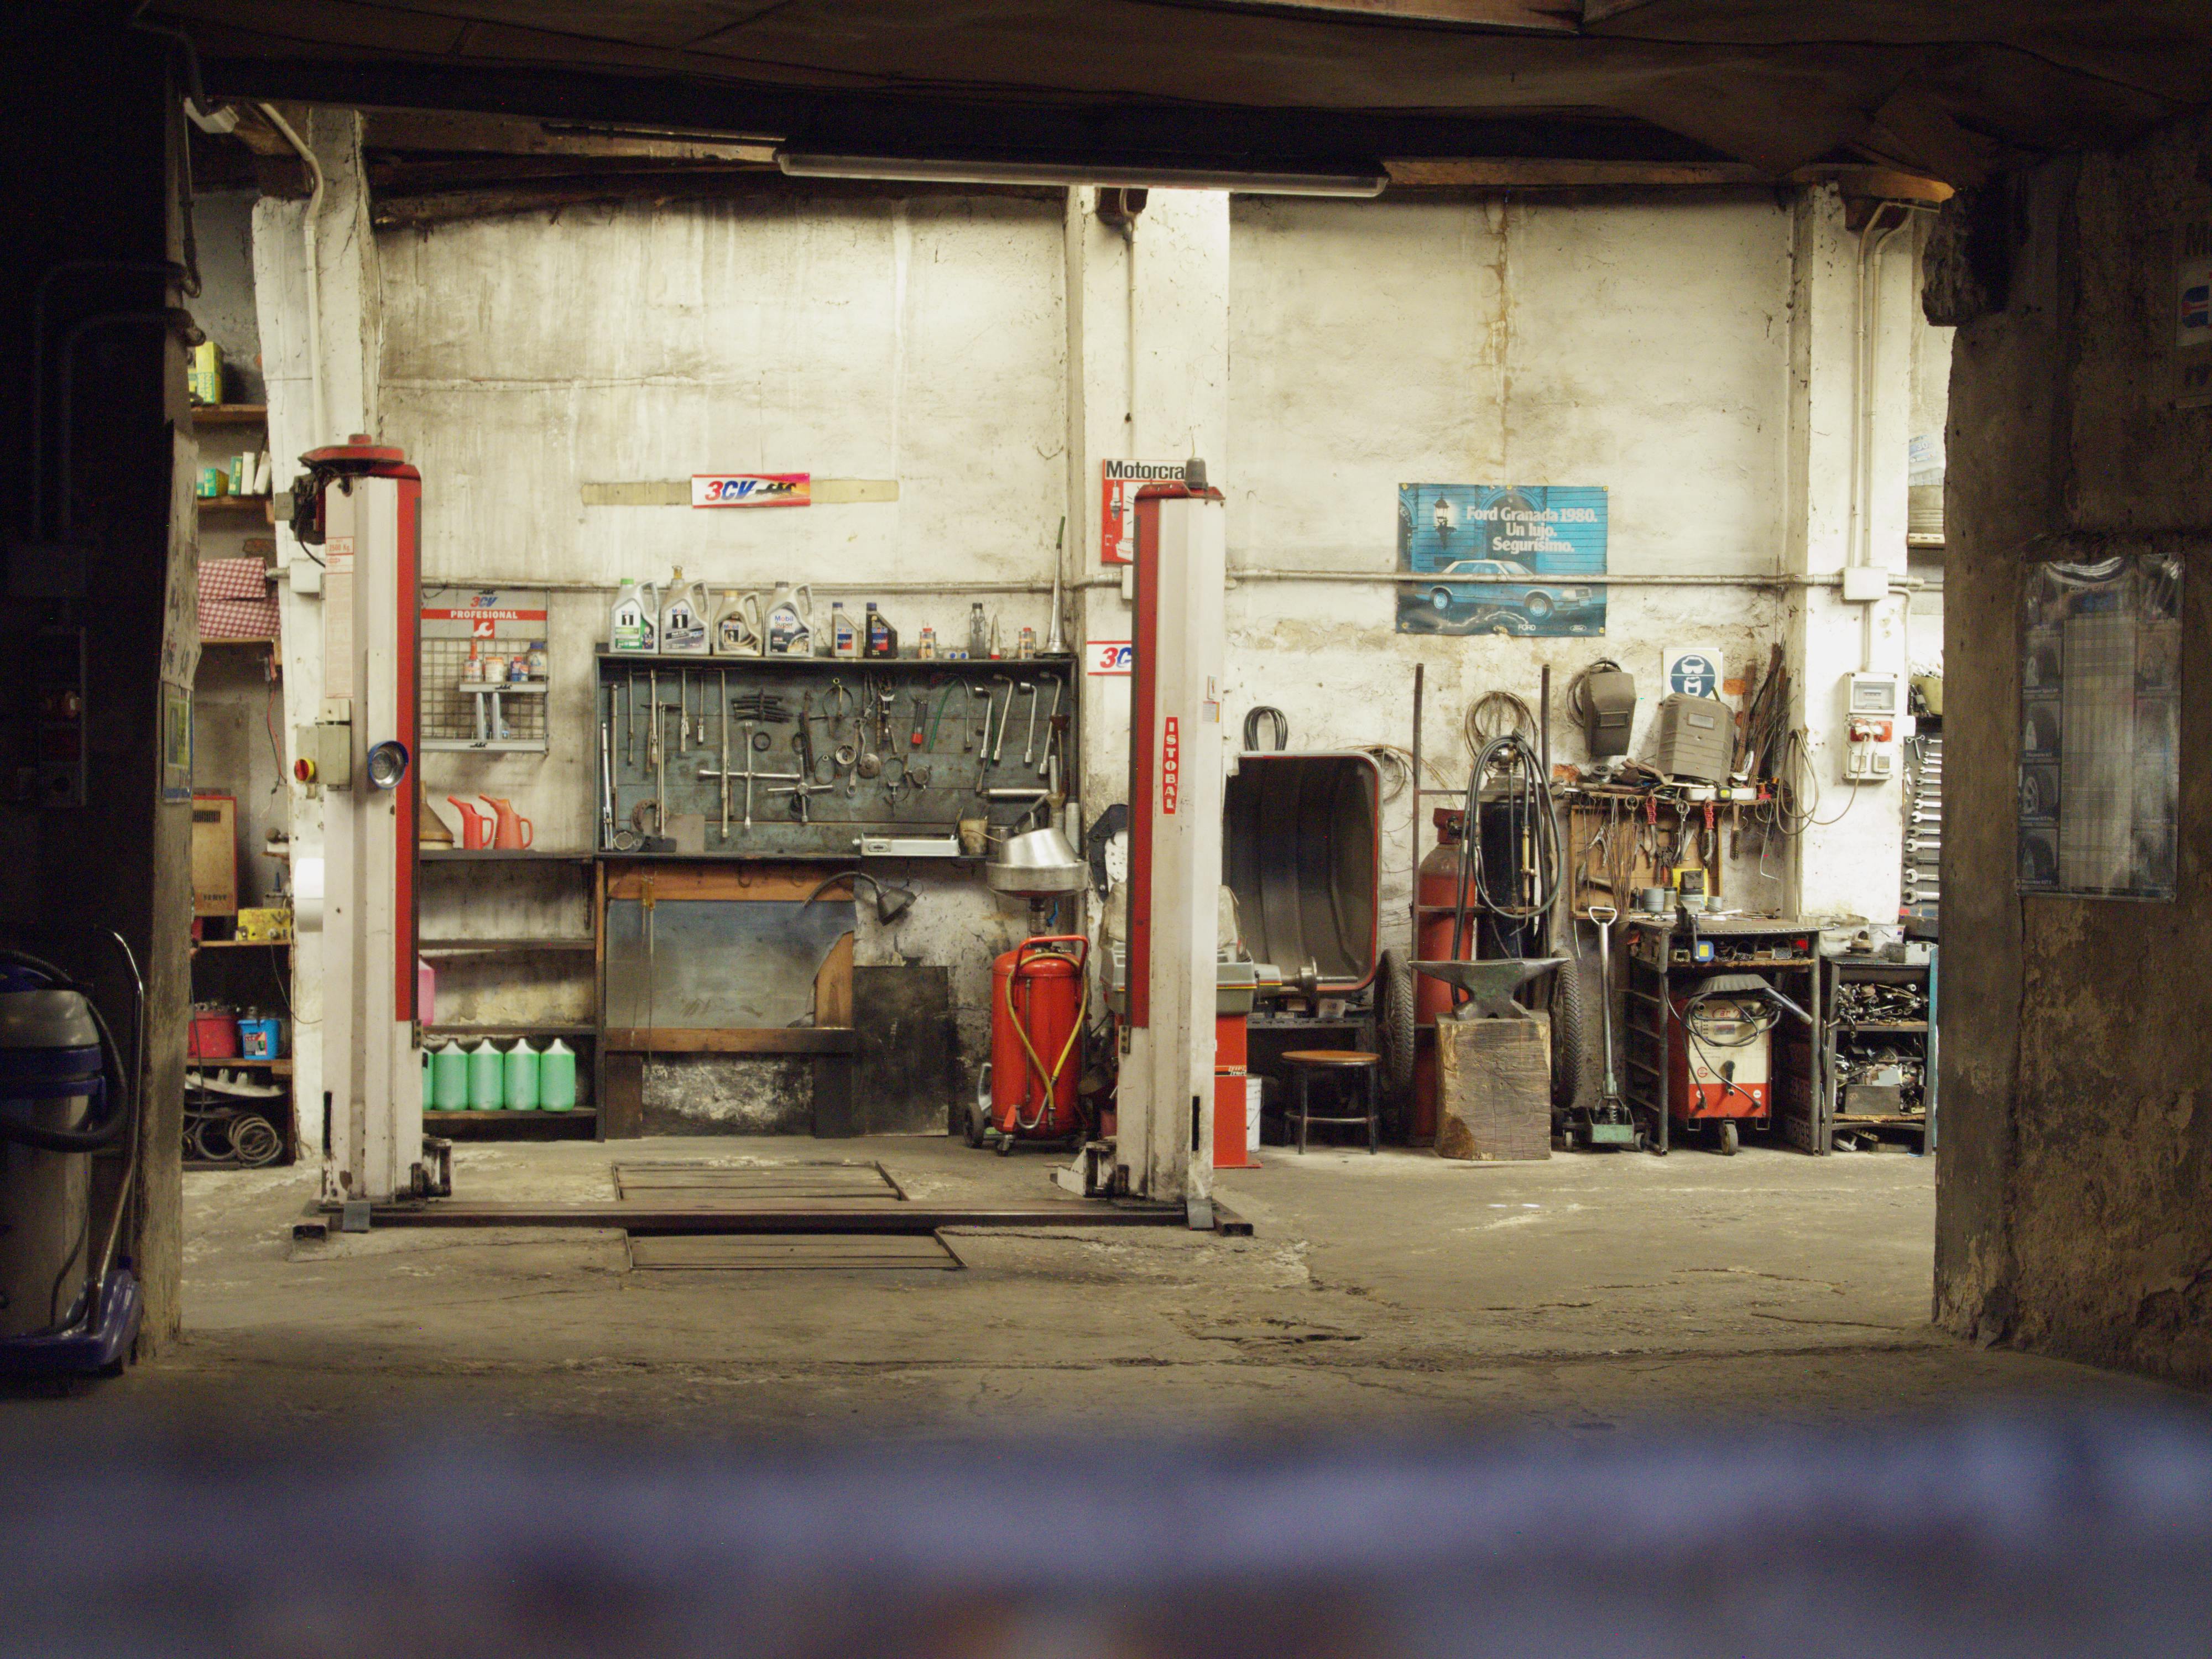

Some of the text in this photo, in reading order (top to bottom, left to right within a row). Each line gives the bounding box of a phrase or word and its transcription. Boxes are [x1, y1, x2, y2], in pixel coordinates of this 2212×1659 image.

[1106, 461, 1185, 479] Motorcra
[705, 480, 758, 501] 3CV
[1467, 506, 1598, 523] Ford Granada 1980.
[1506, 522, 1557, 540] Un lujo.
[1493, 536, 1575, 555] Segurísimo.
[470, 596, 498, 608] 3CV
[450, 610, 518, 619] PROFESIONAL
[1099, 647, 1132, 669] 3C
[1165, 721, 1177, 810] ISTOBAL
